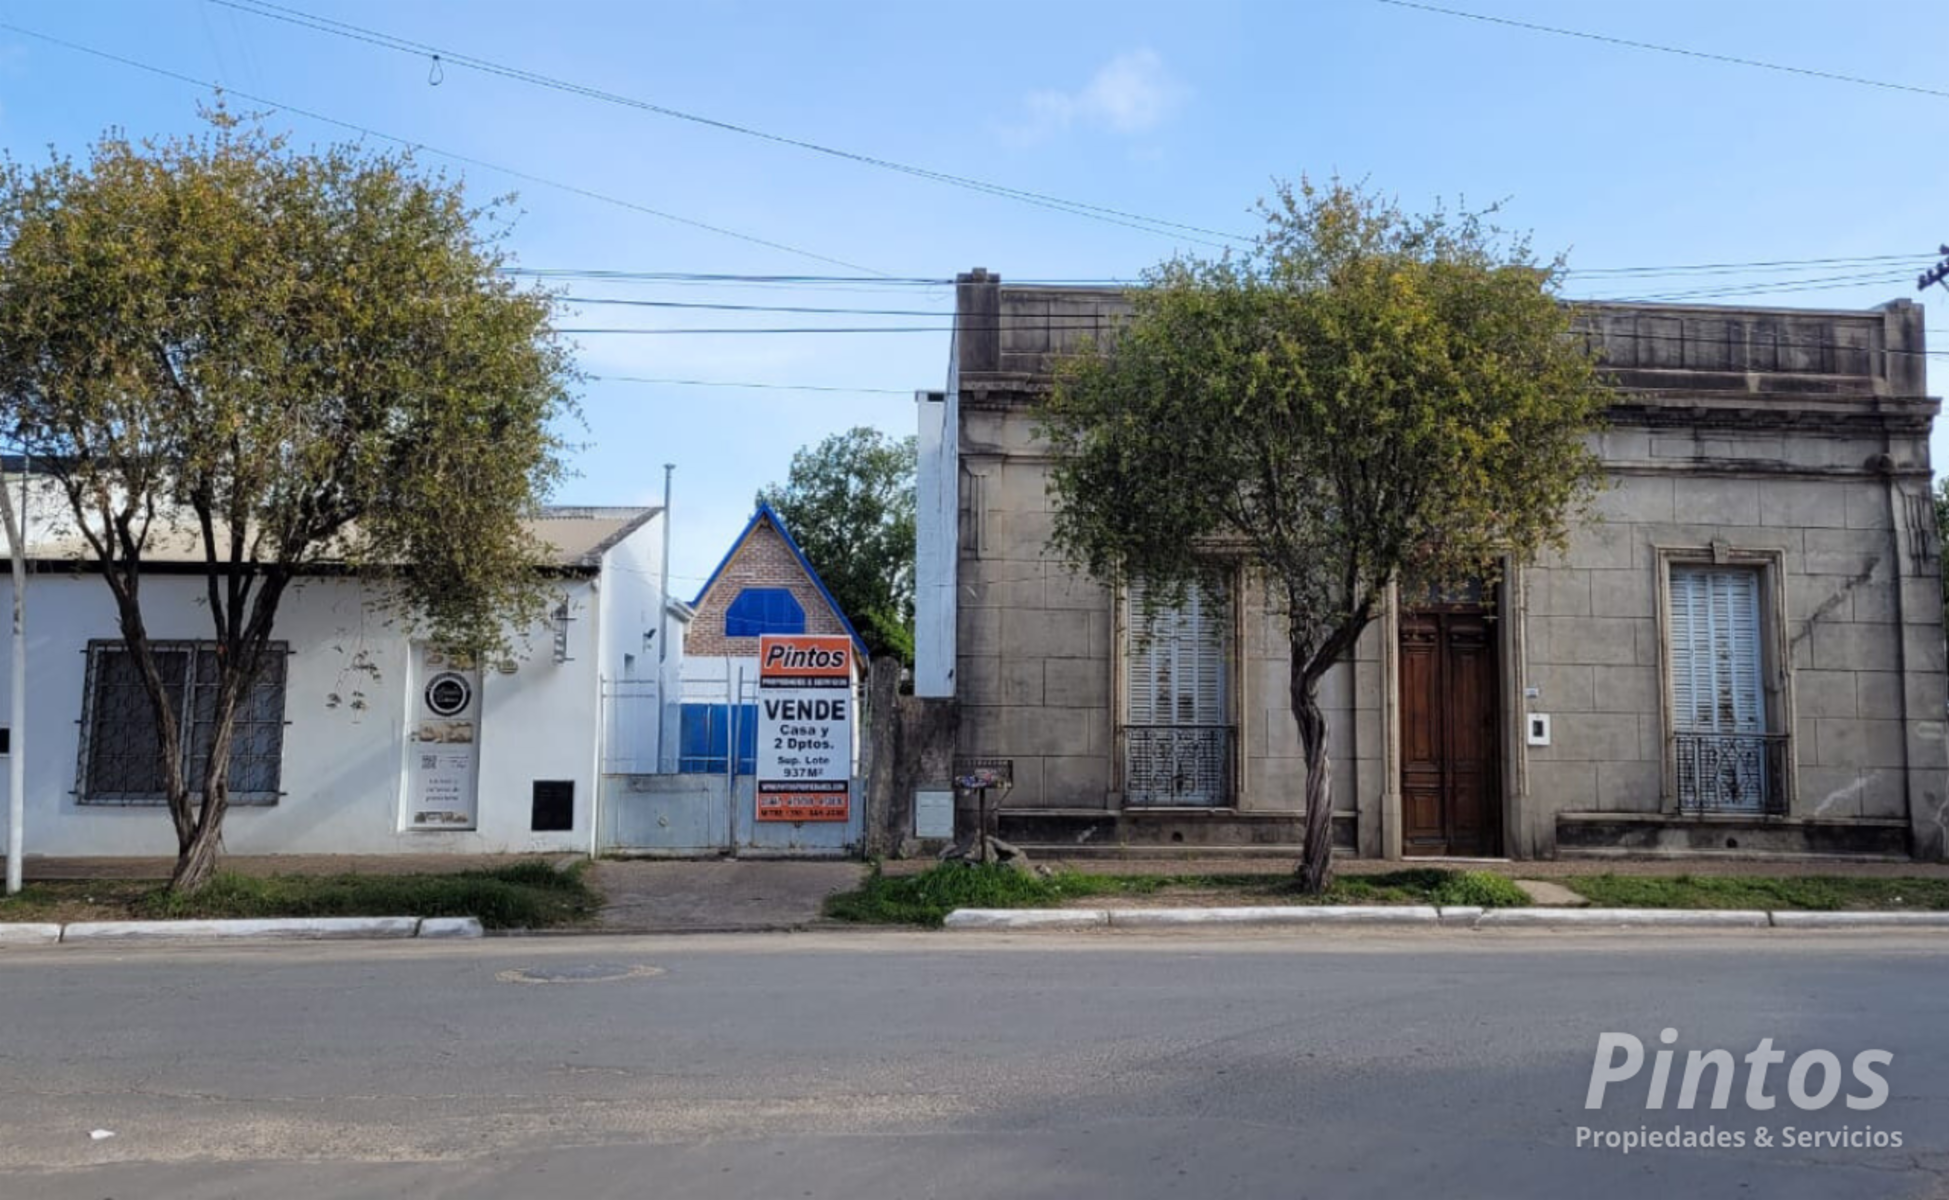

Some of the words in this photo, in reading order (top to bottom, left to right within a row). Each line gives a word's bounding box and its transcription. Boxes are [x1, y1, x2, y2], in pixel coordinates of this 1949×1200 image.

[765, 644, 844, 669] Pintos
[764, 699, 846, 721] VENDE
[780, 724, 816, 736] Casa
[820, 726, 829, 738] y
[774, 738, 783, 749] 2
[787, 738, 835, 752] Dptos.
[777, 756, 801, 766] Sup.
[805, 756, 830, 765] Lote
